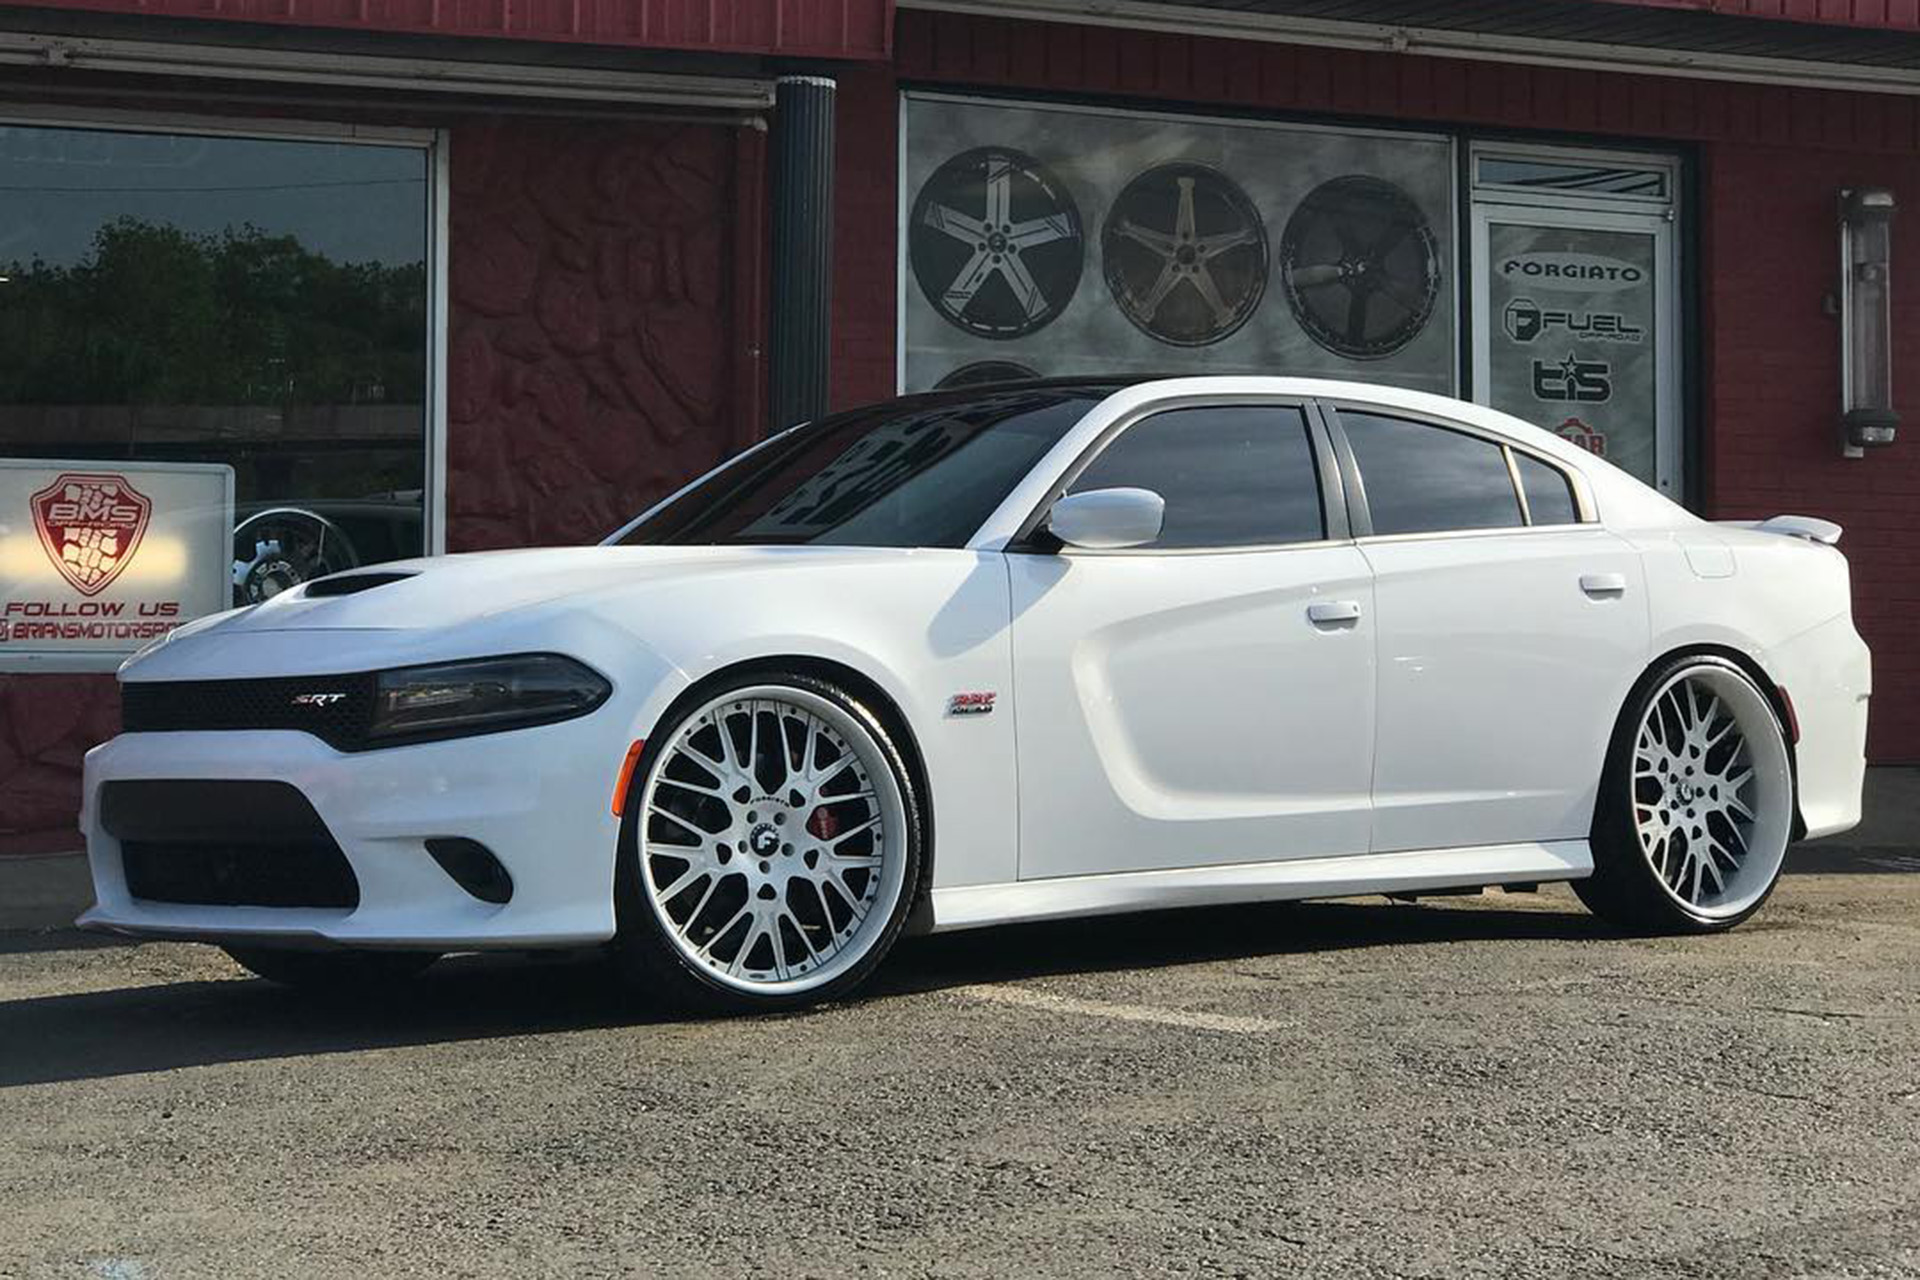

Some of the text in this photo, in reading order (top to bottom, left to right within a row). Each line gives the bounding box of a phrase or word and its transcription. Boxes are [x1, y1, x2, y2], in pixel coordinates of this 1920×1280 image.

[1504, 261, 1641, 281] FORGIATO
[1543, 312, 1640, 333] FUEL
[48, 503, 139, 521] BMS
[5, 602, 180, 616] FOLLOW US
[291, 693, 346, 706] SRT
